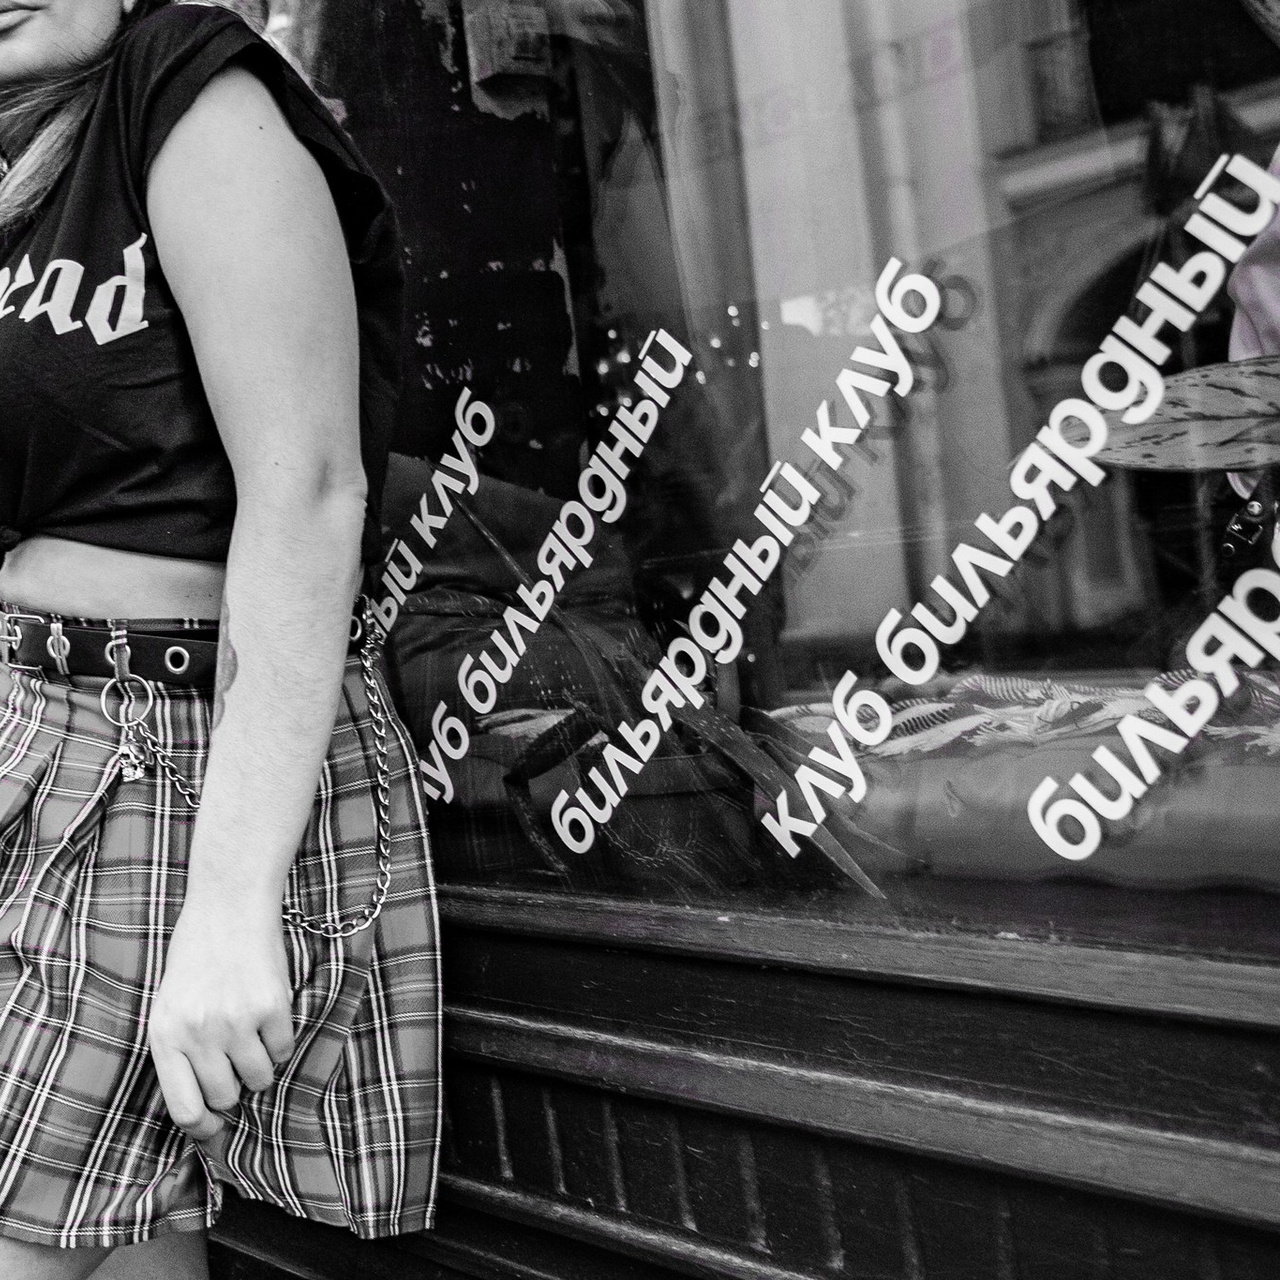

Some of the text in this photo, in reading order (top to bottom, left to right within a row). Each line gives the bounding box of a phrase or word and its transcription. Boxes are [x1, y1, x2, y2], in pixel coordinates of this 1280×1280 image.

[409, 386, 495, 548] клуб
[457, 328, 693, 715] бильярдный
[551, 257, 941, 855] бильярдный клуб
[761, 153, 1280, 859] клуб бильярдный
[1027, 522, 1280, 861] бильяр
